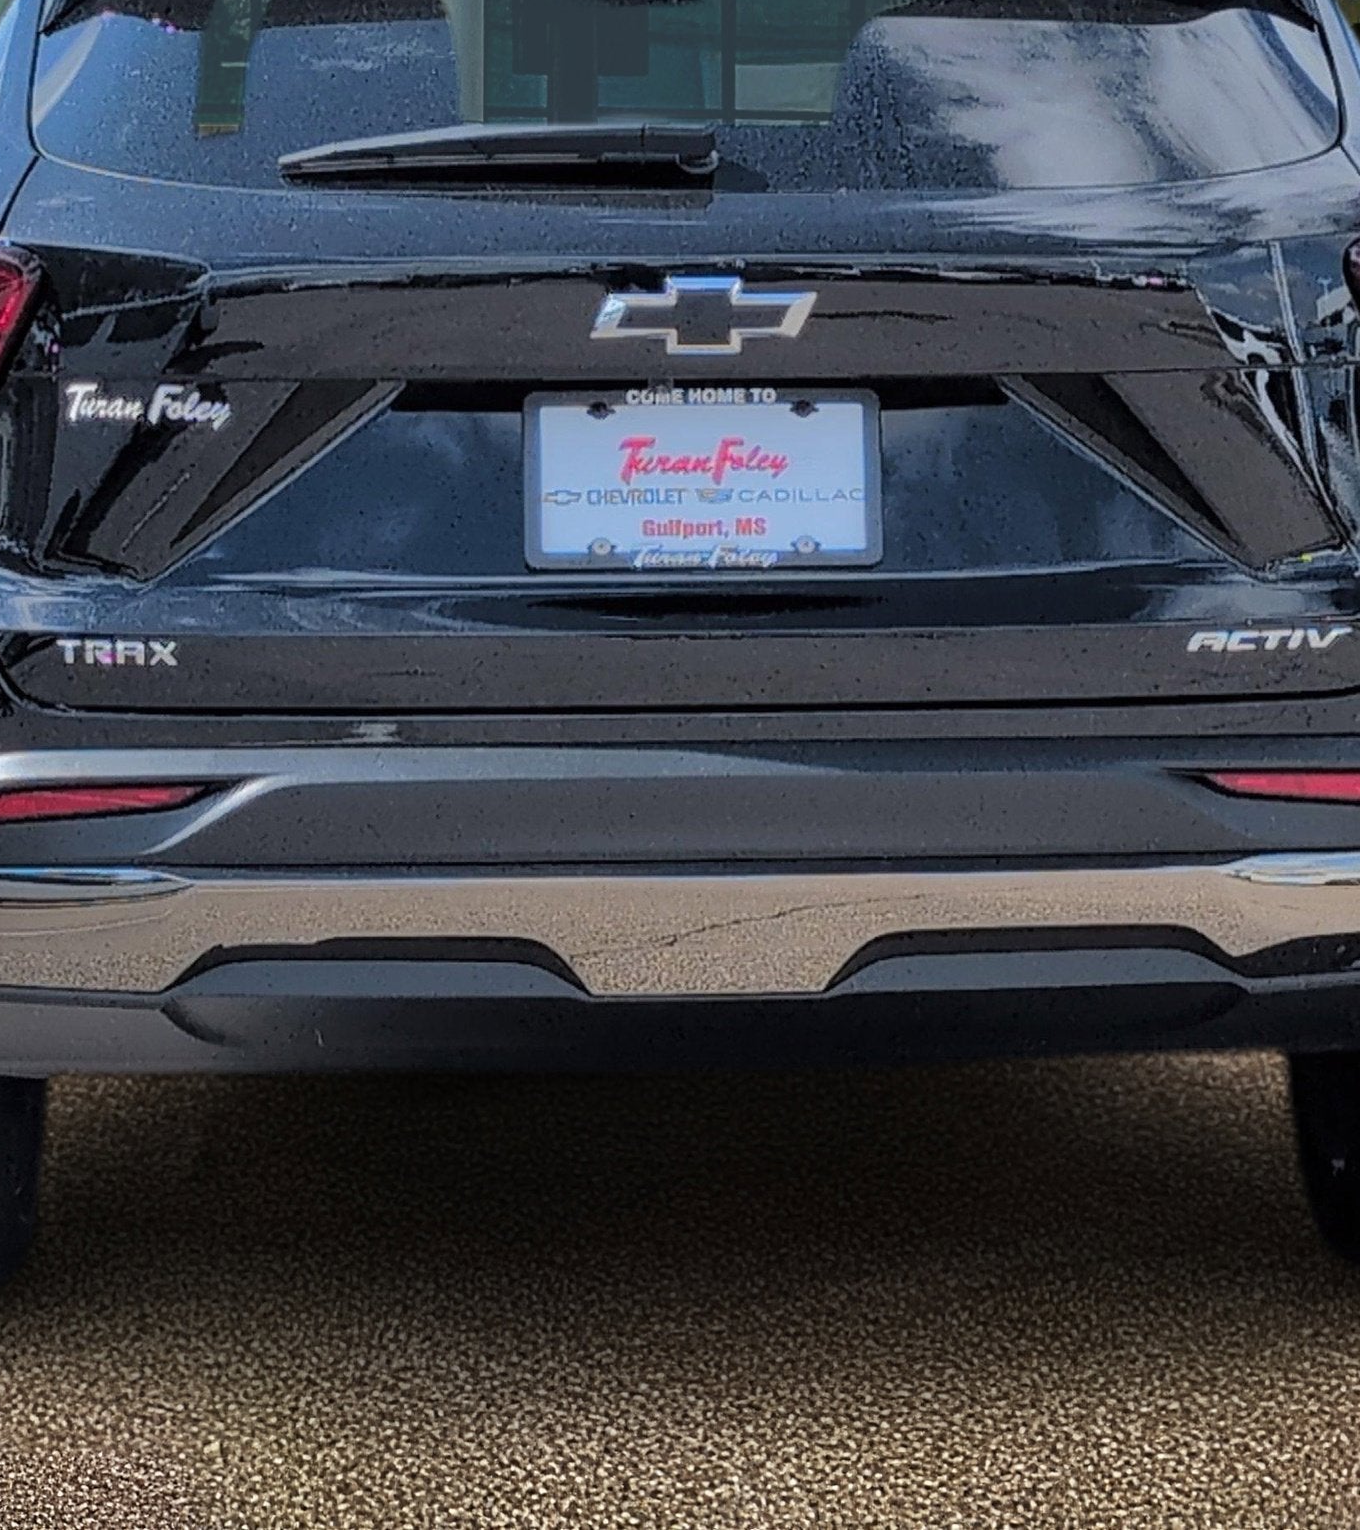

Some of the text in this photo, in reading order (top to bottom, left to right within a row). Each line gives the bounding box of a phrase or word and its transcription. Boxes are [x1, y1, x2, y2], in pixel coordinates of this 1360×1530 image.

[65, 381, 233, 431] Turan Foley
[625, 388, 778, 405] COME HOME TO
[619, 436, 789, 485] Turan Foley
[586, 487, 865, 506] CHEVROLET CADILLAC
[642, 518, 767, 538] Gulfport, MS
[1187, 627, 1353, 652] ACTIV
[56, 639, 178, 666] TRAX
